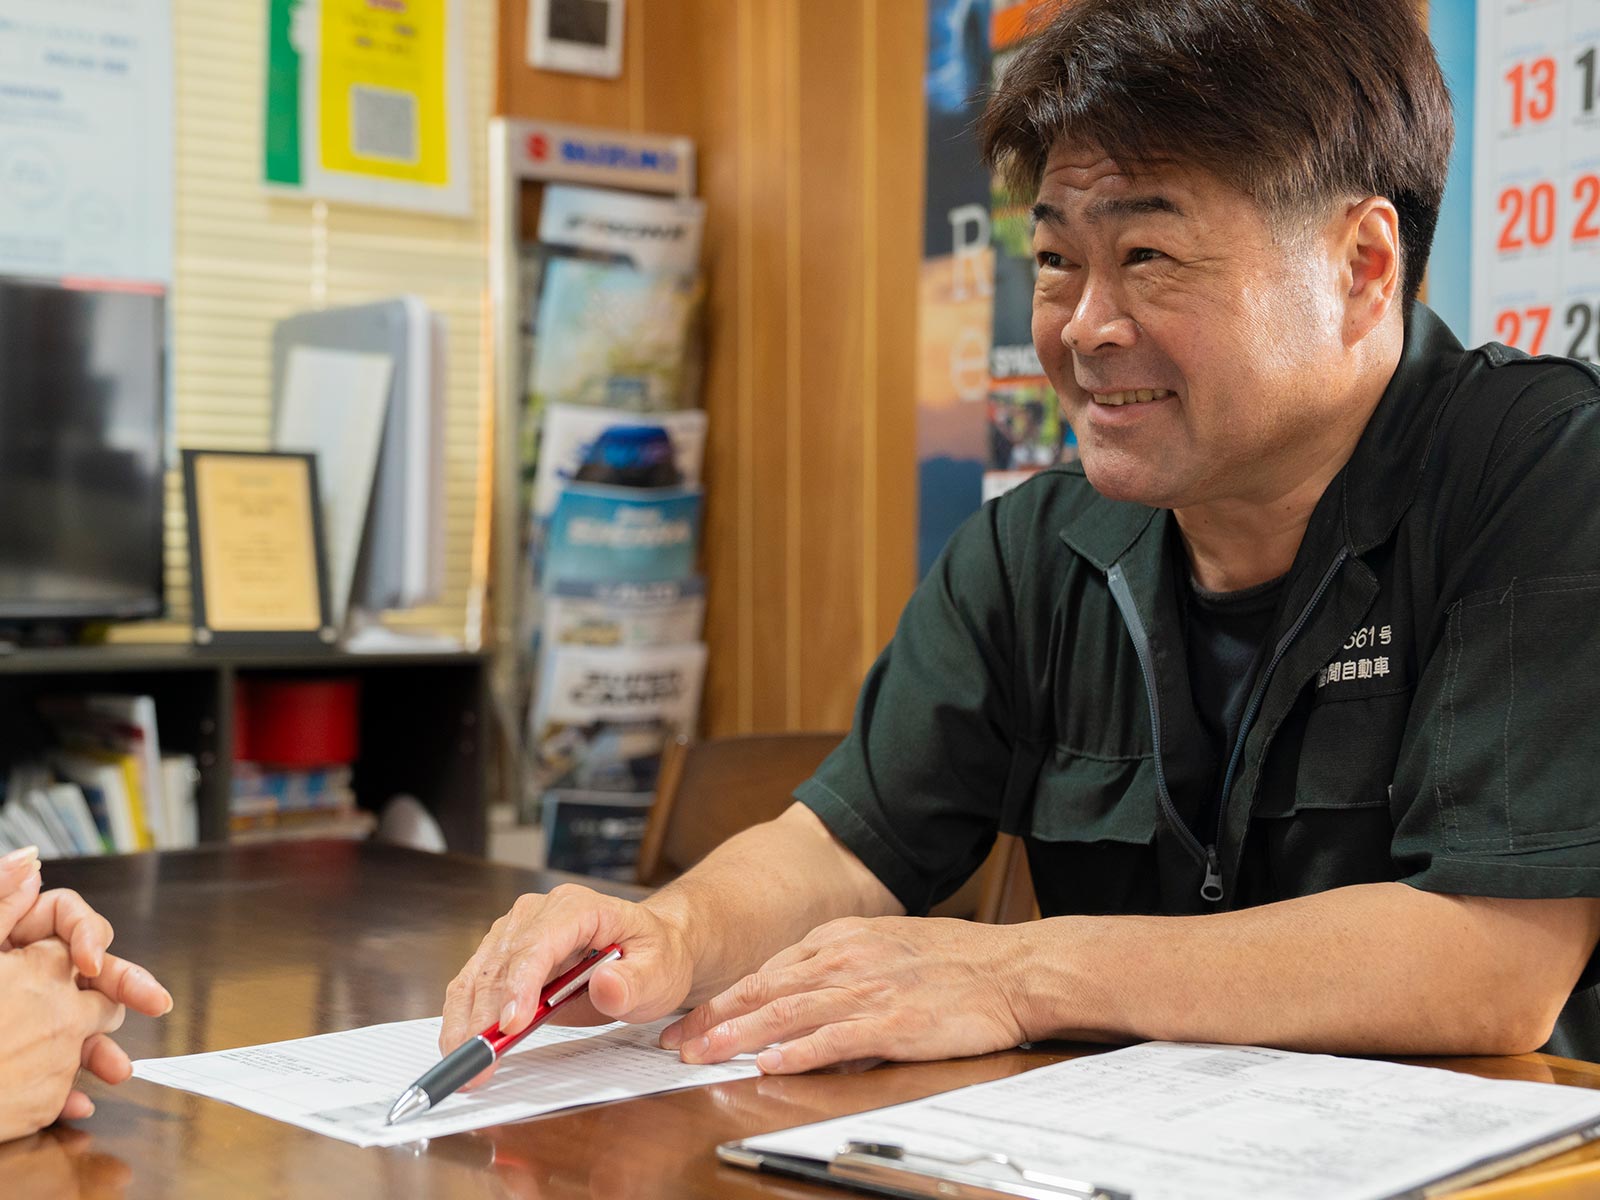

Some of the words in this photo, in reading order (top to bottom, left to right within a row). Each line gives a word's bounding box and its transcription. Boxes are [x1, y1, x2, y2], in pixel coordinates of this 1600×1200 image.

[1503, 57, 1557, 129] 13
[1574, 47, 1600, 113] 1
[1496, 181, 1556, 252] 20
[1494, 307, 1552, 357] 27
[1566, 303, 1600, 362] 2
